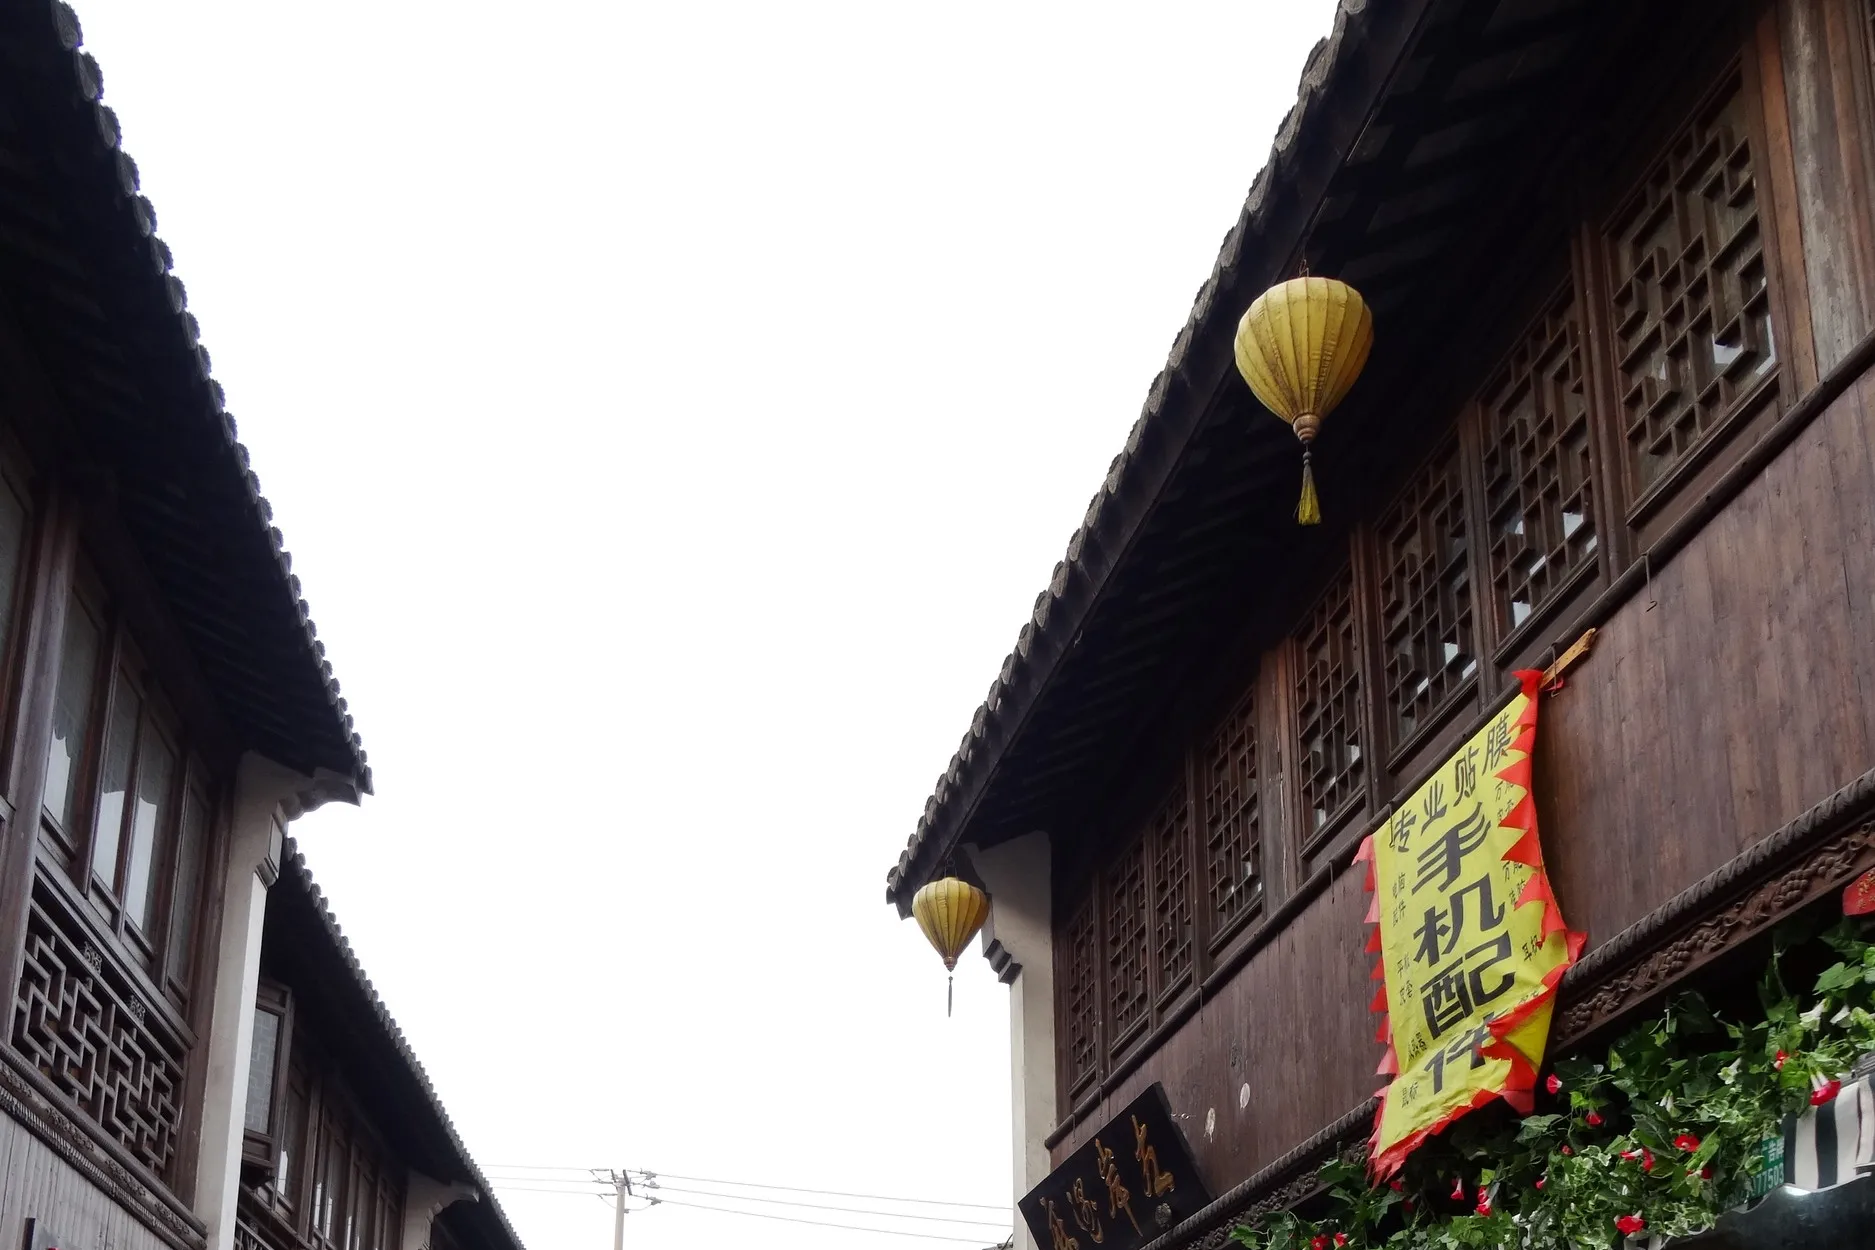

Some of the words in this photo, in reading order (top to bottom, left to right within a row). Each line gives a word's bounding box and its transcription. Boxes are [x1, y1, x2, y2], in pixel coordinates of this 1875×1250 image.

[1392, 712, 1512, 853] 专业贴膜
[1411, 802, 1516, 1095] 手机配件
